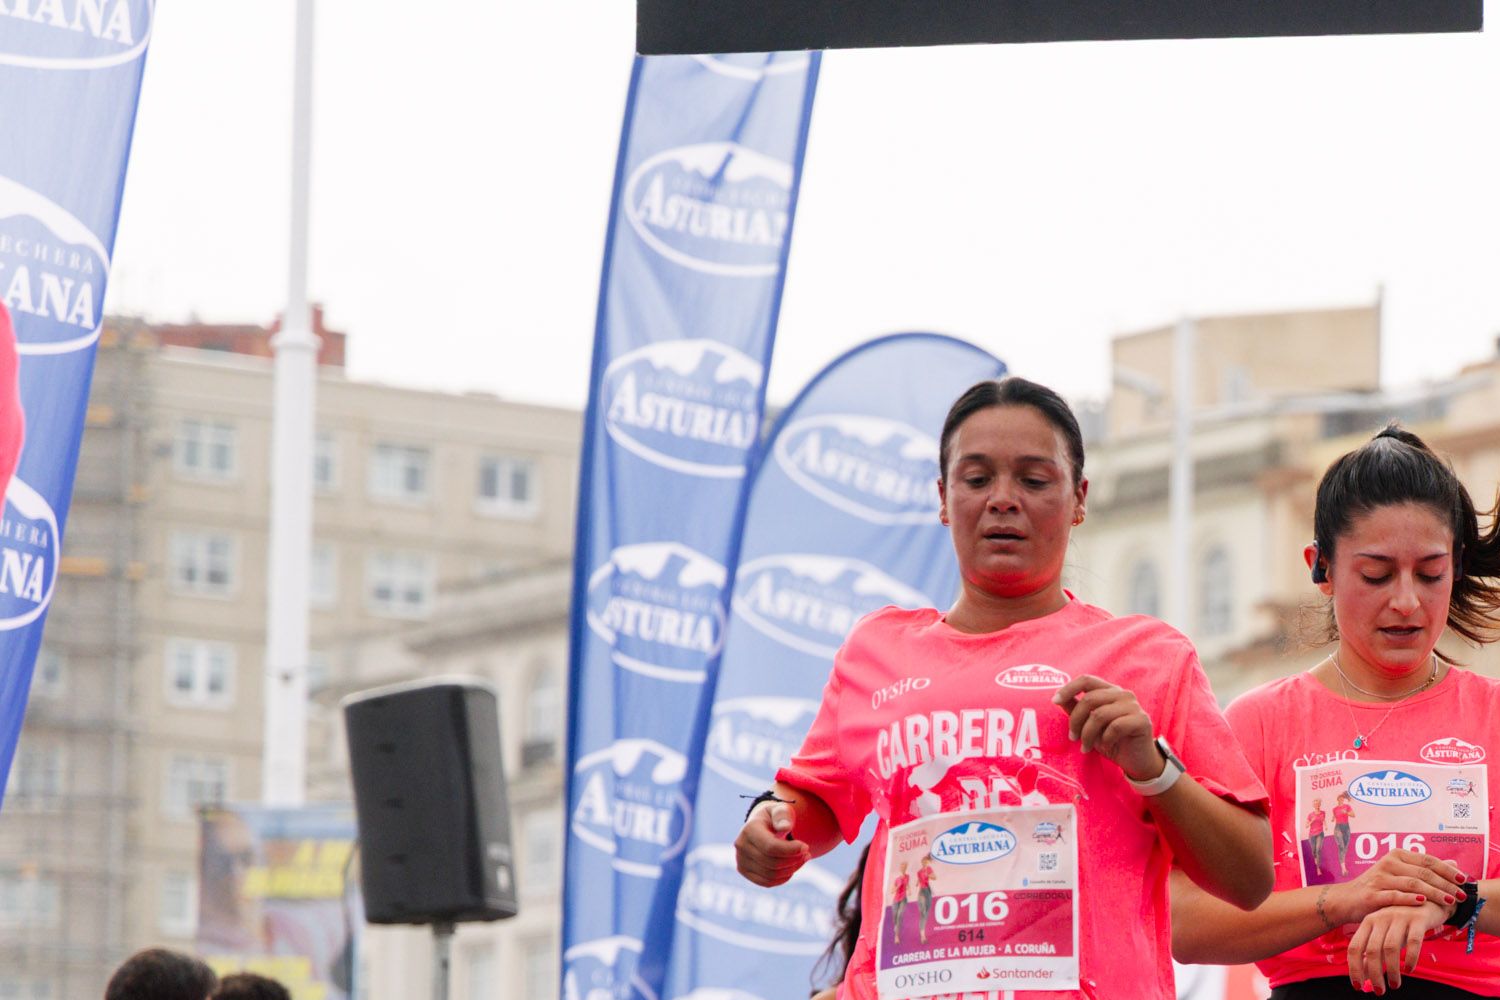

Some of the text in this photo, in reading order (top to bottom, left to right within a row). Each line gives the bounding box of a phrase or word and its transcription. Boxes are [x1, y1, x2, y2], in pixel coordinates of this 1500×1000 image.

[1002, 673, 1066, 685] ASTURIANA
[872, 677, 931, 711] OYSHO
[877, 707, 1042, 780] CARRERA
[1426, 748, 1481, 760] ASTURIANA
[1312, 777, 1343, 790] SUMA
[1355, 783, 1426, 798] ASTURIANA
[899, 838, 929, 853] SUMA
[937, 839, 1010, 857] ASTURIANA
[934, 891, 1008, 925] 016
[958, 929, 984, 942] 614
[893, 950, 931, 965] CARRERA
[933, 948, 945, 958] DE
[947, 946, 960, 957] LA
[962, 944, 995, 956] MUJER
[1004, 944, 1012, 954] A
[1014, 942, 1056, 954] CORUÑA
[895, 967, 1054, 989] OYSHO Santander
